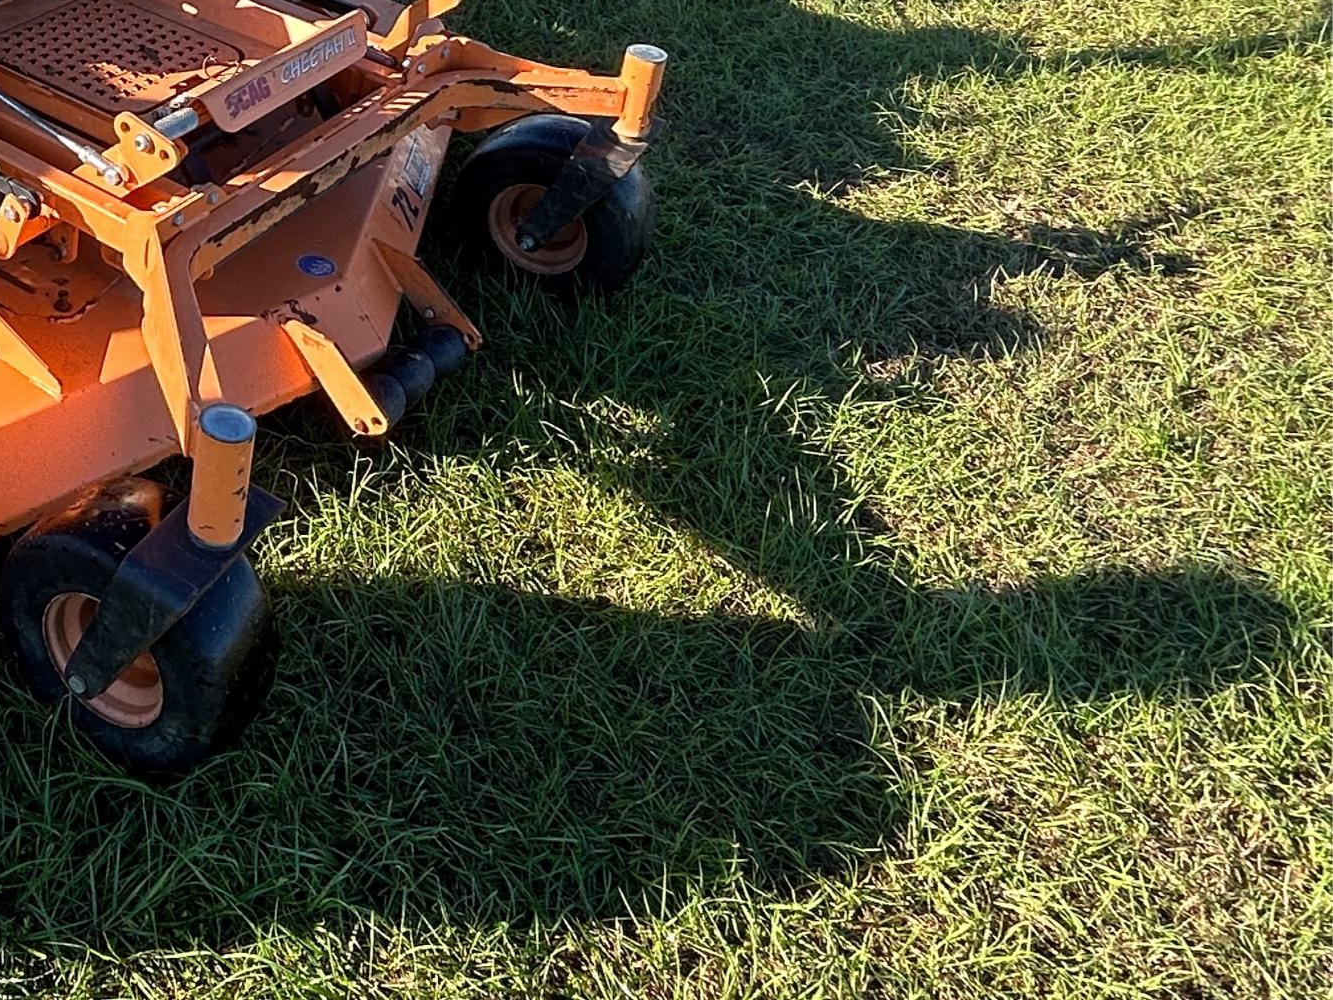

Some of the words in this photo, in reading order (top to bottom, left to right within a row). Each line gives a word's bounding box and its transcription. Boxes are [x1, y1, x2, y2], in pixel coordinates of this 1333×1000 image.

[223, 75, 272, 119] SCAG
[280, 33, 345, 84] CHEETAH
[391, 186, 420, 233] 72
